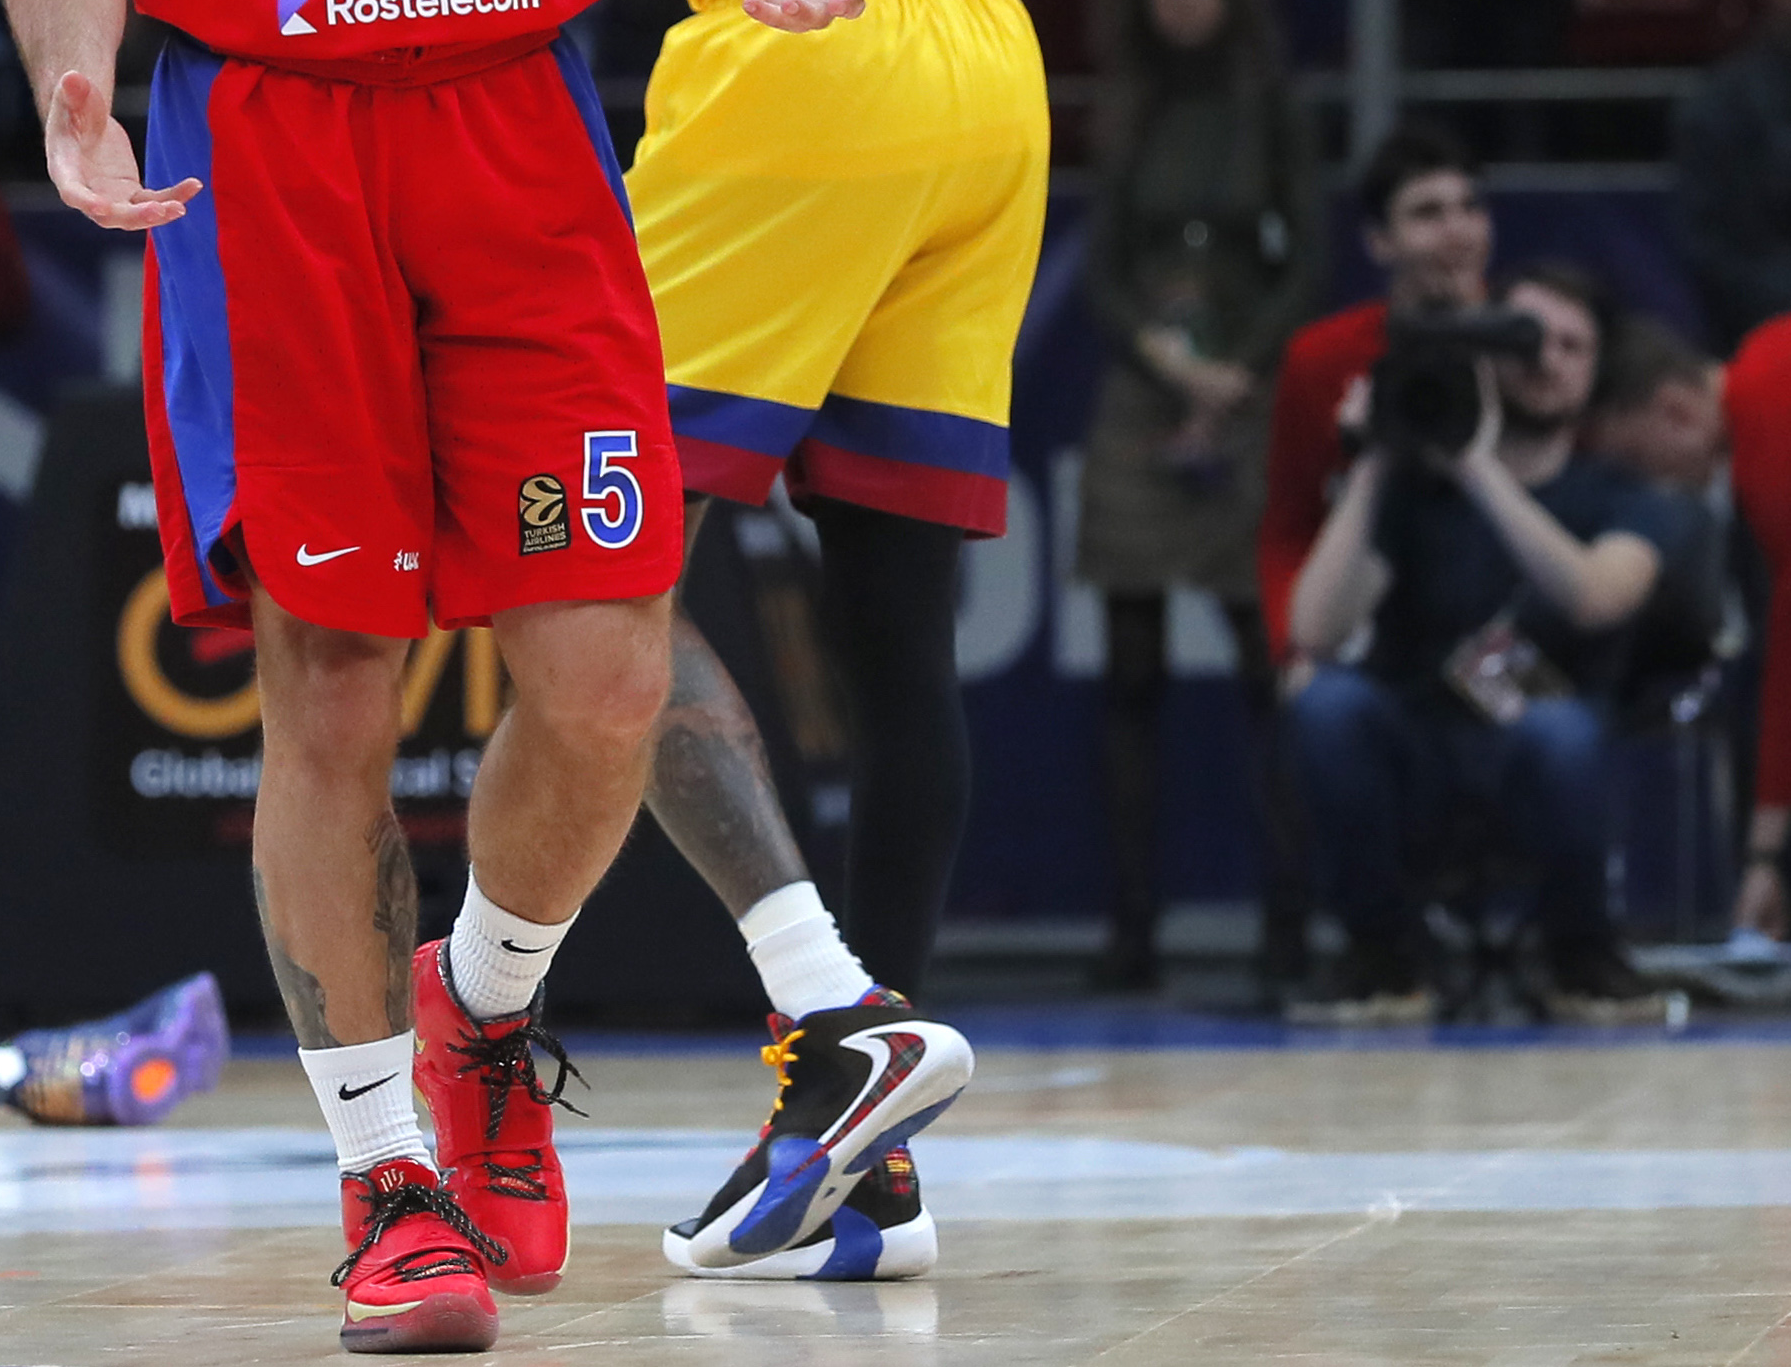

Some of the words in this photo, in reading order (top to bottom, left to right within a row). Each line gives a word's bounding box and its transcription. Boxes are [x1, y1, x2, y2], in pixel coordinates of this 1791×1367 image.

[580, 431, 644, 550] 5
[523, 523, 566, 539] TURKISH
[525, 533, 567, 547] AIRLINES
